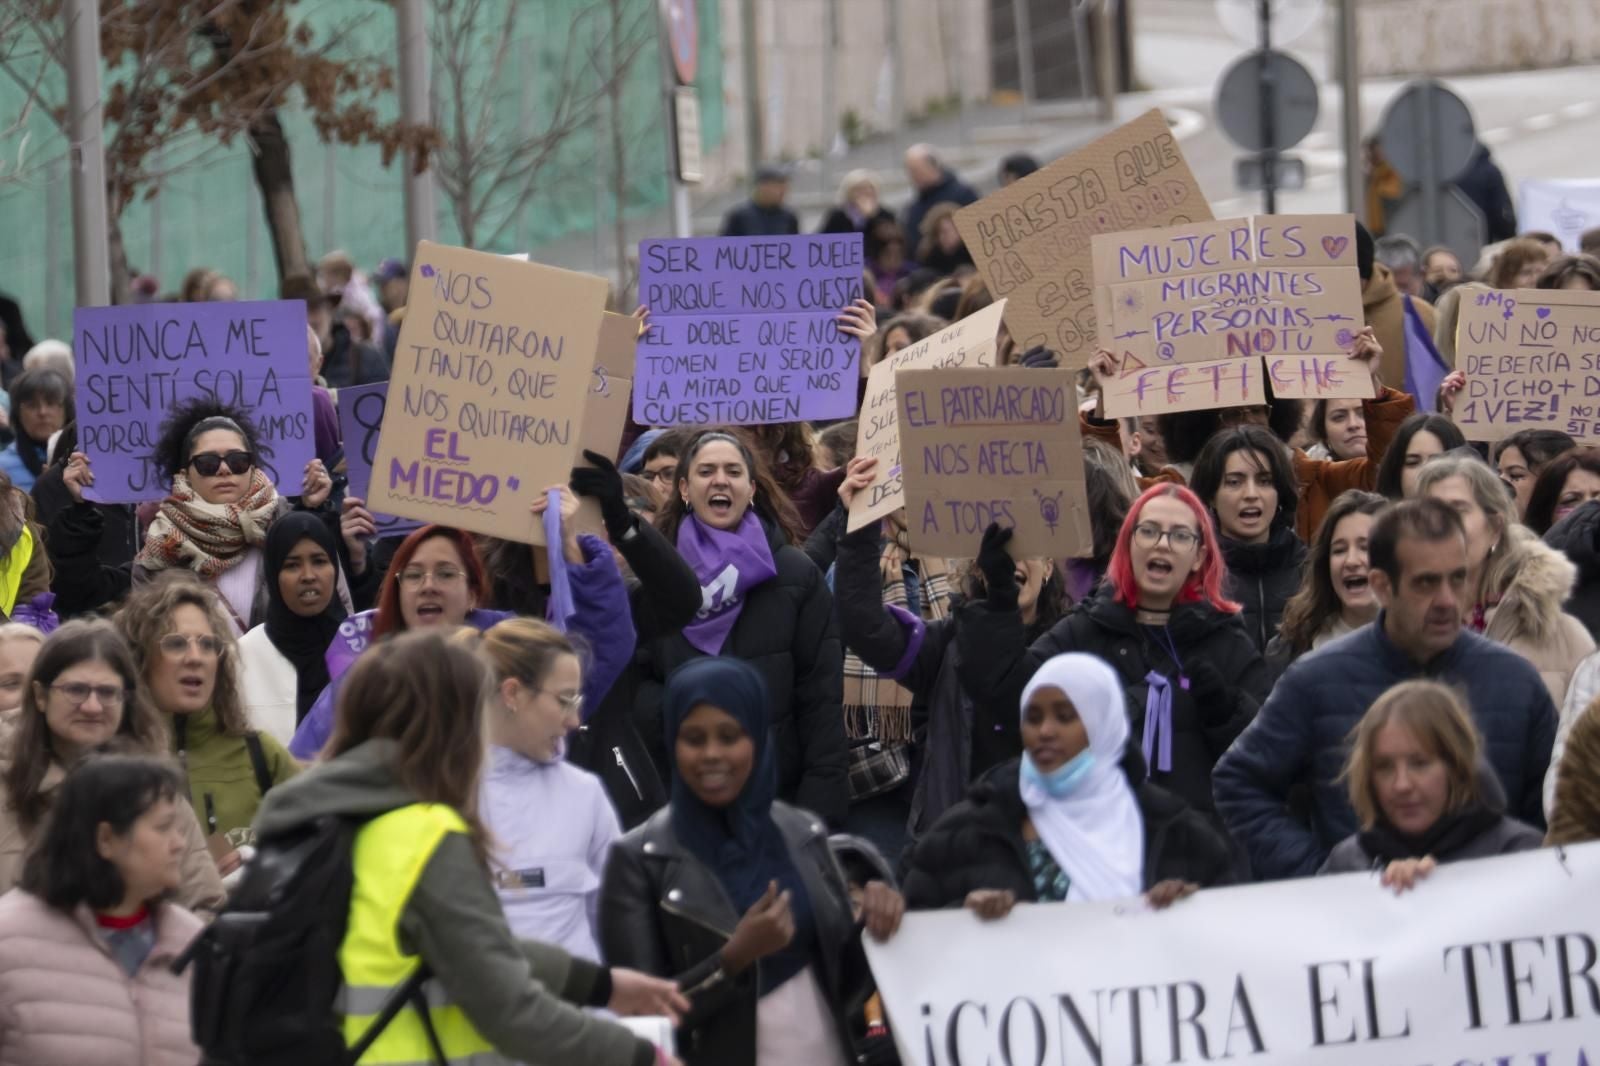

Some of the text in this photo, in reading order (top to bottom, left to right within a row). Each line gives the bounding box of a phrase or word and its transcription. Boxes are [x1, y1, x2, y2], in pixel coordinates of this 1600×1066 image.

[977, 133, 1180, 257] HASTA QUE
[648, 241, 862, 273] SER MUJER DUELE
[1119, 226, 1307, 277] MUJERES
[988, 250, 1034, 296] LA
[1162, 271, 1322, 302] MIGRANTES
[649, 277, 862, 313] PORQUE NOS CUESTA
[83, 318, 271, 365] NUNCA ME
[433, 310, 564, 361] QUITARON
[645, 324, 673, 345] EL
[687, 319, 740, 345] DOBLE
[758, 320, 797, 346] QUE
[890, 343, 929, 372] PARA
[941, 325, 966, 345] QUE
[1226, 328, 1312, 356] NO TU
[1468, 321, 1508, 344] UN
[1520, 320, 1558, 344] NO
[410, 345, 498, 396] TANTO,
[508, 368, 558, 400] QUE
[645, 354, 717, 375] TOMEN
[738, 352, 767, 373] EN
[841, 348, 858, 371] Y
[1467, 351, 1570, 376] DEBERÍA
[87, 367, 281, 414] SENTÍ SOLA
[646, 380, 670, 401] LA
[754, 375, 791, 394] QUE
[807, 372, 841, 391] NOS
[404, 384, 570, 446] NOS QUITARON
[905, 384, 1064, 427] EL PATRIARCADO
[1570, 404, 1593, 418] NO
[83, 420, 157, 454] PORQU
[424, 428, 470, 462] EL
[923, 443, 970, 476] NOS
[978, 439, 1049, 475] AFECTA
[922, 500, 1017, 534] A TODES
[1305, 957, 1411, 1044] EL
